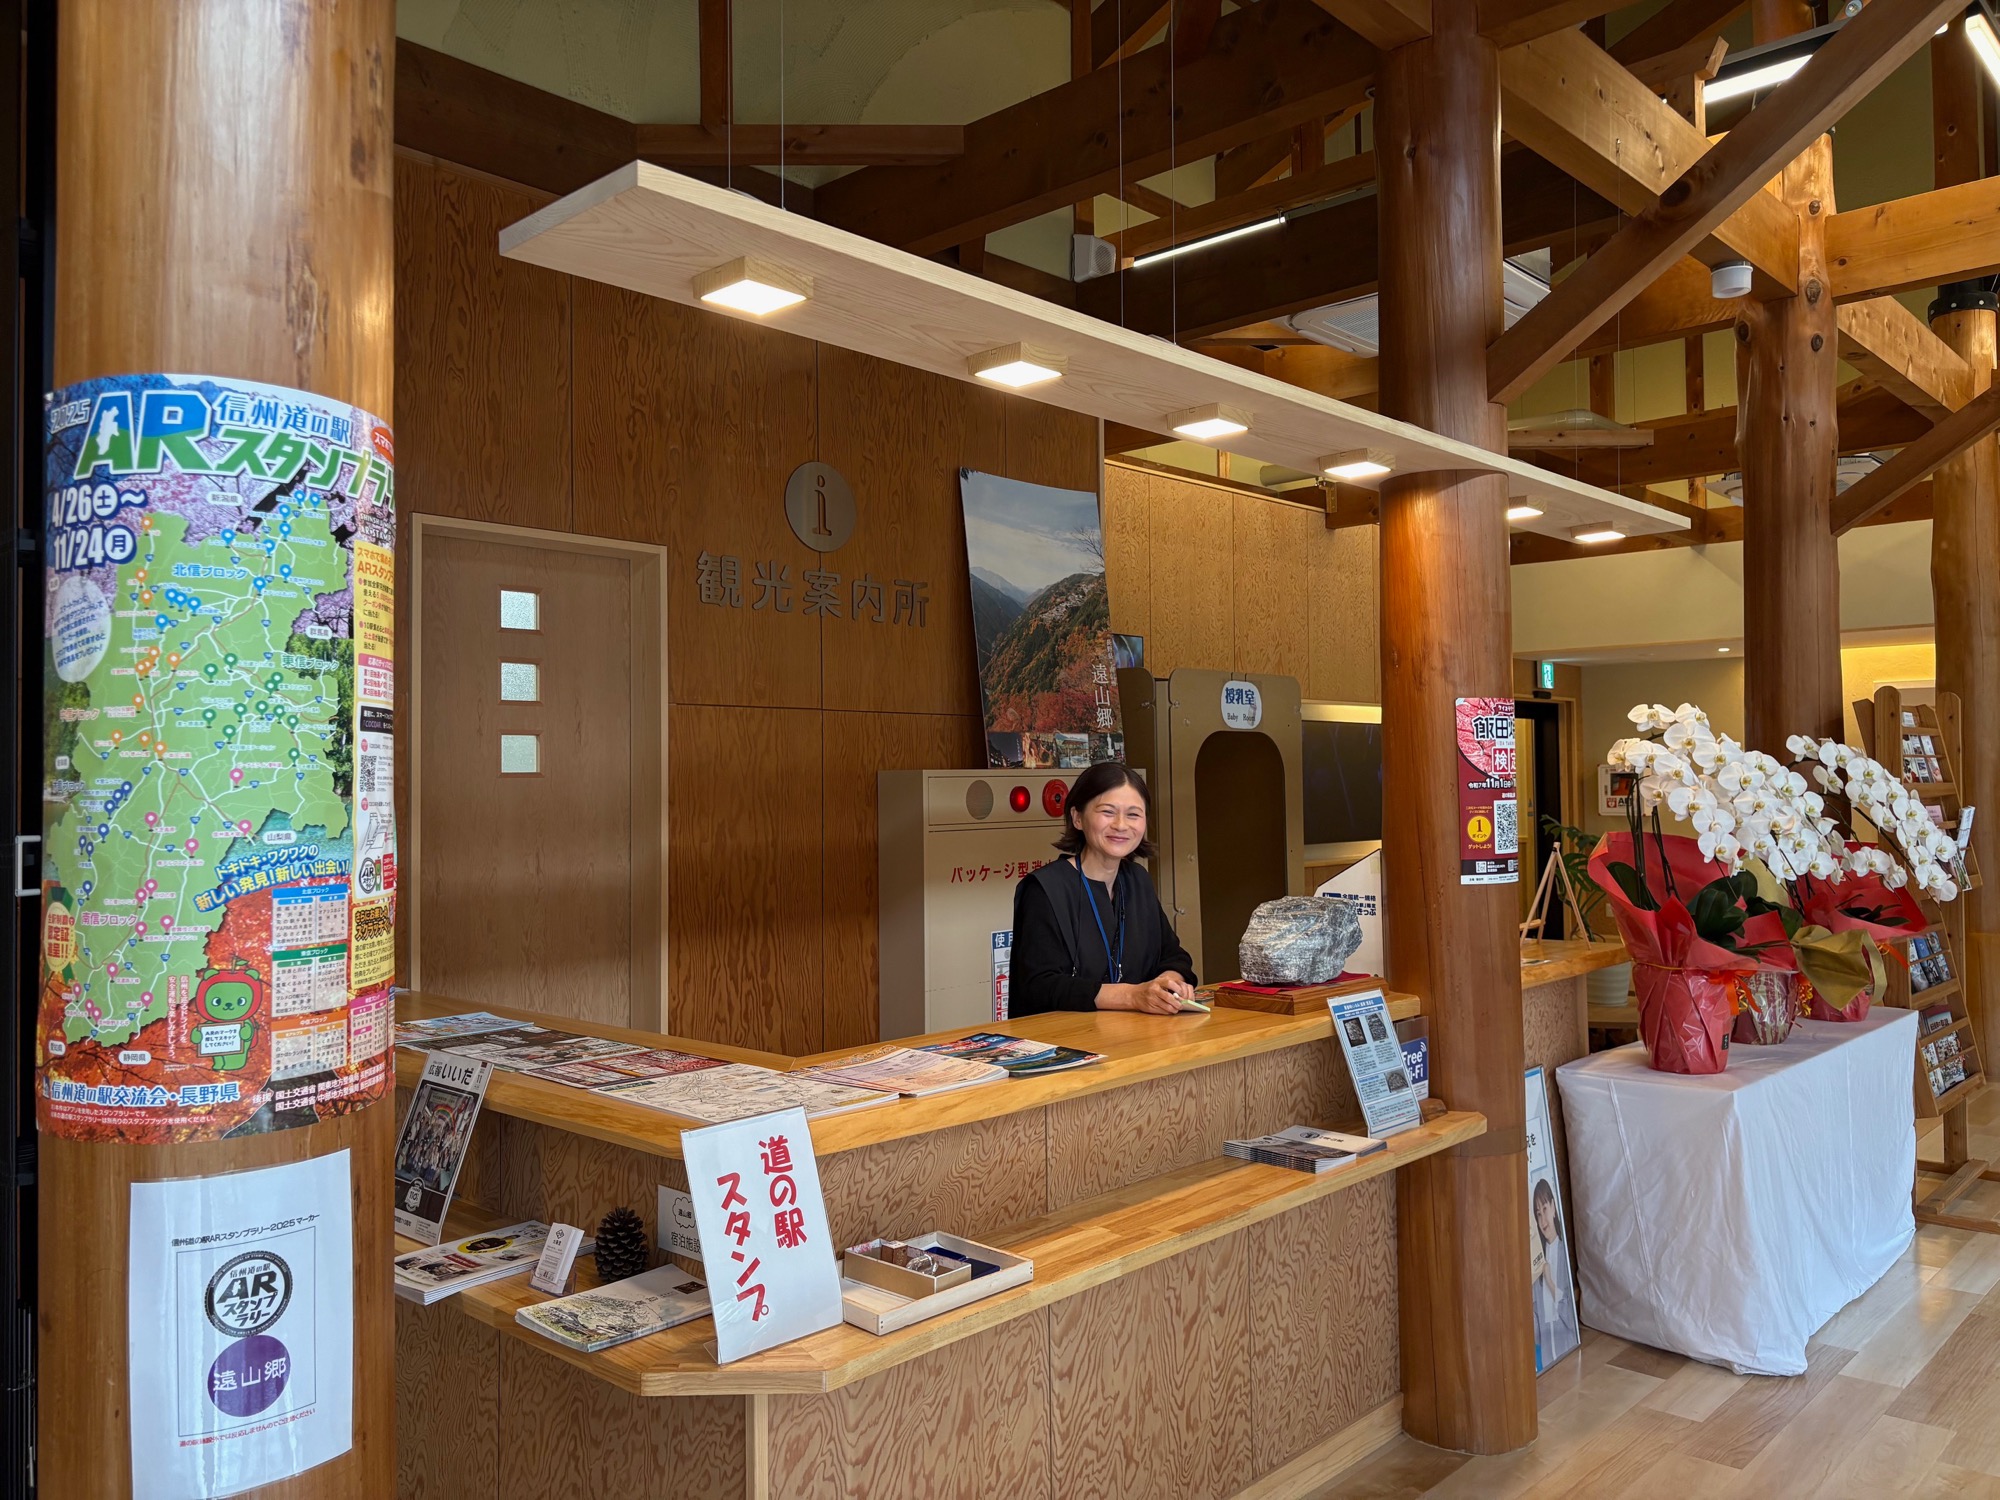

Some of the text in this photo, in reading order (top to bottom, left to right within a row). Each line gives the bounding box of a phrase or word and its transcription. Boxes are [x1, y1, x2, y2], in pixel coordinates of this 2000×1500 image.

[217, 394, 351, 446] 信州道の駅
[73, 390, 212, 480] AR
[172, 562, 248, 580] 北信ブロック
[696, 550, 930, 629] 観光案内所
[282, 655, 339, 671] 東信ブロック
[1091, 663, 1114, 729] 遠山郷
[1225, 687, 1255, 706] 授乳室
[1227, 712, 1238, 722] Baby
[1476, 819, 1483, 833] 1
[267, 832, 292, 842] 山梨県
[216, 845, 319, 879] ドキドキ・ワクワクの
[81, 912, 138, 926] 南信ブロック
[123, 1053, 146, 1063] 静岡県
[1401, 1050, 1423, 1066] Free
[51, 1082, 240, 1107] 信州道の駅交流会・長野県
[275, 1084, 317, 1101] 国土交通省
[275, 1096, 317, 1112] 国土交通省
[758, 1135, 808, 1250] 道の駅
[716, 1172, 770, 1322] スタンプ
[229, 1262, 271, 1279] 信州道の駅
[215, 1270, 279, 1305] AR
[222, 1291, 279, 1318] スタンプ
[234, 1312, 271, 1328] ラリー
[213, 1356, 287, 1392] 遠山郷
